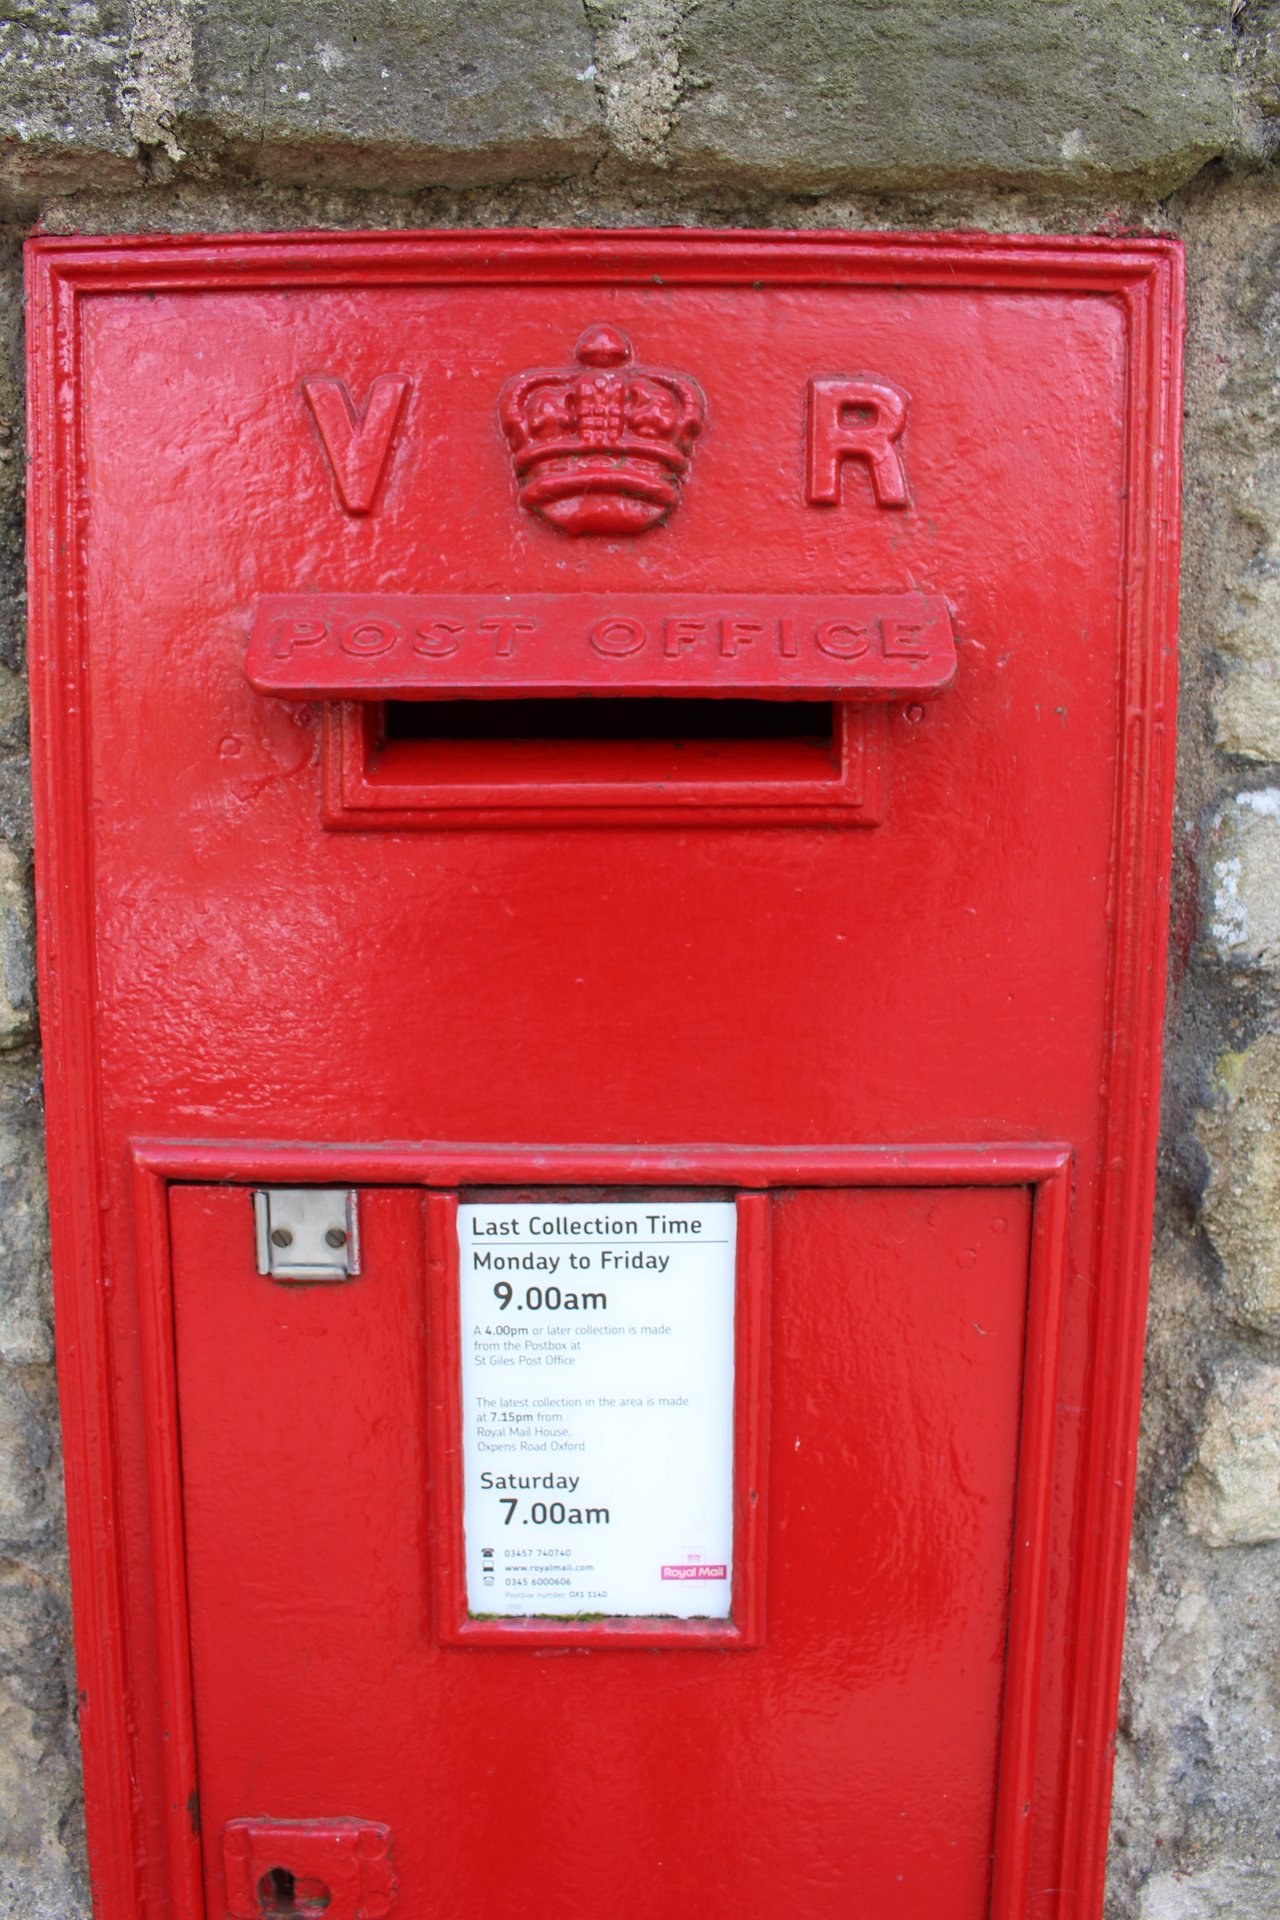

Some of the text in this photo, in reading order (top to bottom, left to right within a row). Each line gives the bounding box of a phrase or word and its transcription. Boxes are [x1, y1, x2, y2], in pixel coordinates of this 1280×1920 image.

[301, 373, 911, 517] V R
[272, 615, 931, 660] POST OFFICE
[472, 1215, 703, 1236] Last Collection Time
[473, 1251, 670, 1274] Monday to Friday
[493, 1281, 607, 1311] 9.00am
[474, 1325, 672, 1337] A 4.00pm or later collection is made
[474, 1340, 581, 1351] from the Postbox at
[475, 1355, 576, 1366] St Giles Post Office
[476, 1396, 689, 1408] The latest collection in the area is made
[477, 1411, 563, 1423] at 7.15pm from
[477, 1426, 572, 1438] Royal Mail House,
[478, 1441, 586, 1452] Oxpens Road Oxford
[480, 1472, 580, 1493] Saturday
[499, 1498, 611, 1526] 7.00am
[504, 1562, 594, 1573] www.royalmail.com
[663, 1566, 724, 1579] Royal Mail
[504, 1577, 529, 1586] 0345
